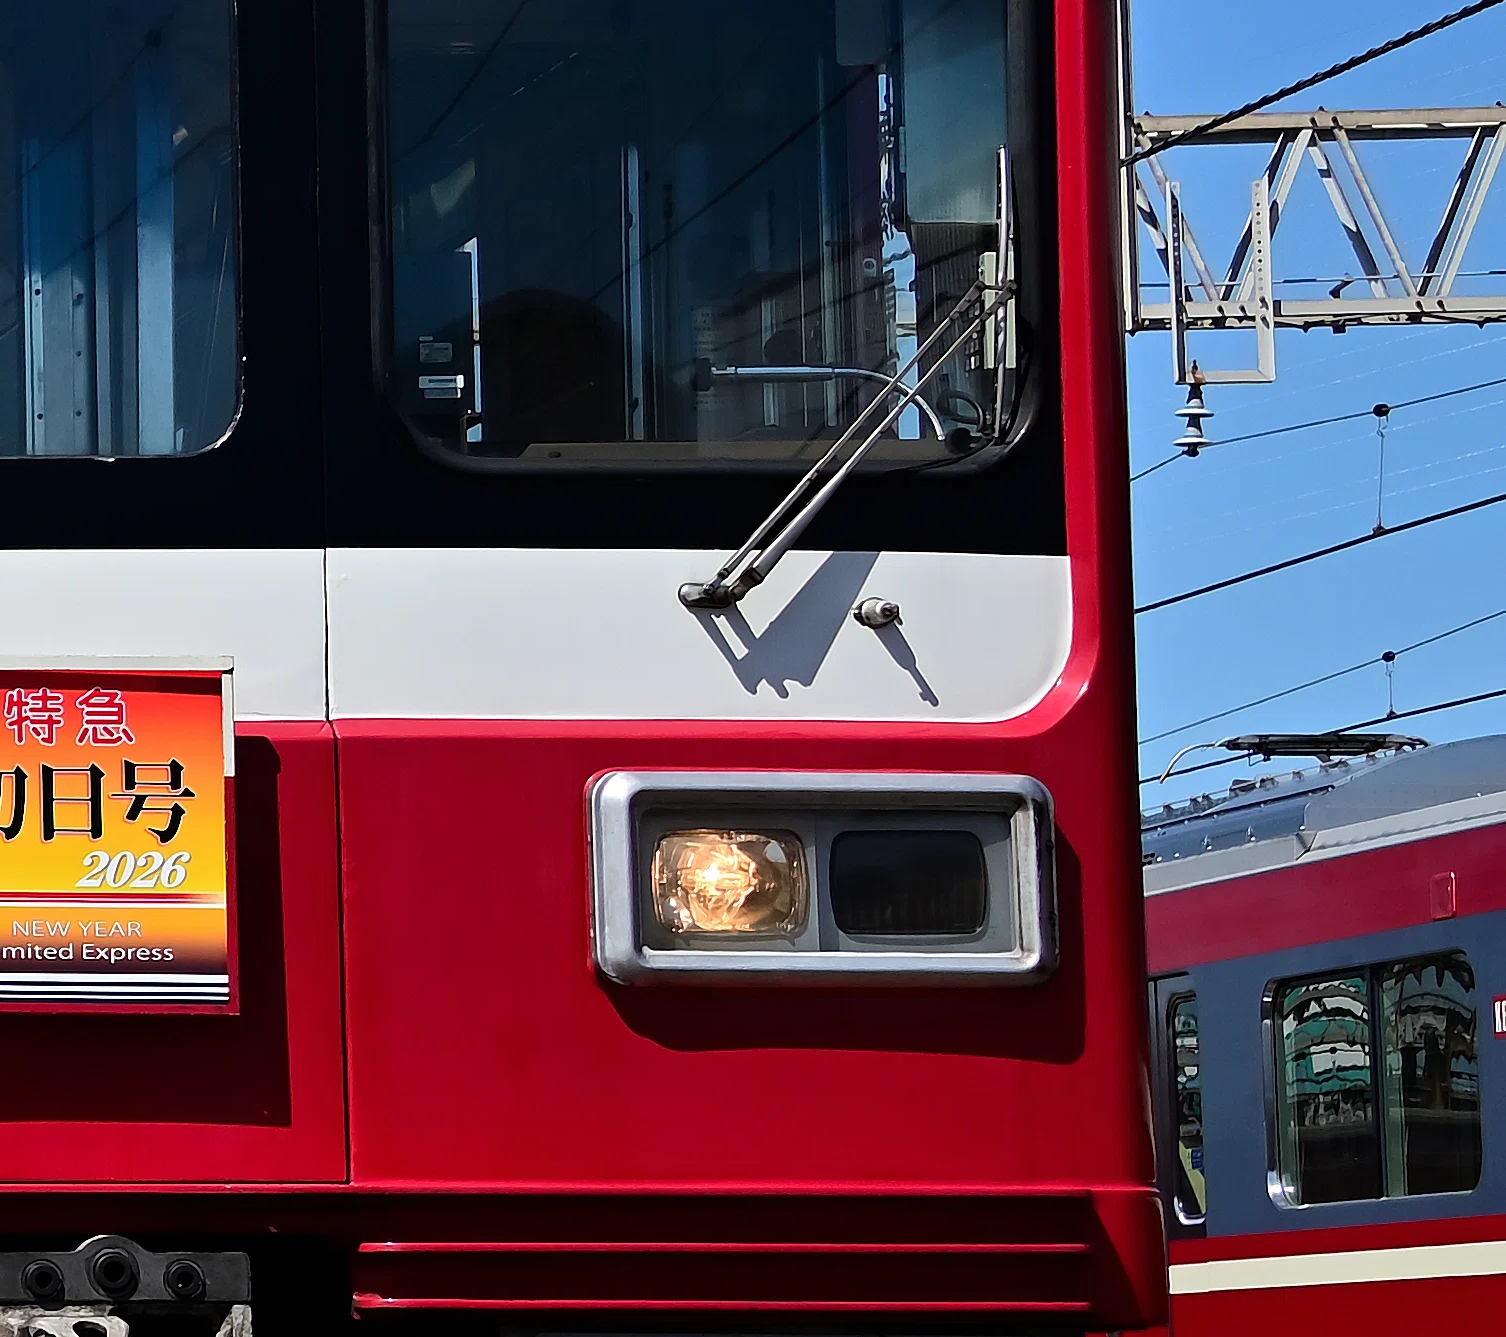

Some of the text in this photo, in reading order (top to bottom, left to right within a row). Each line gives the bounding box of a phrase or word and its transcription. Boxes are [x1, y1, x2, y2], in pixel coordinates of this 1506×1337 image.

[3, 687, 136, 747] 特急
[75, 851, 192, 888] 2026
[12, 921, 142, 938] NEW YEAR
[82, 943, 174, 964] Express
